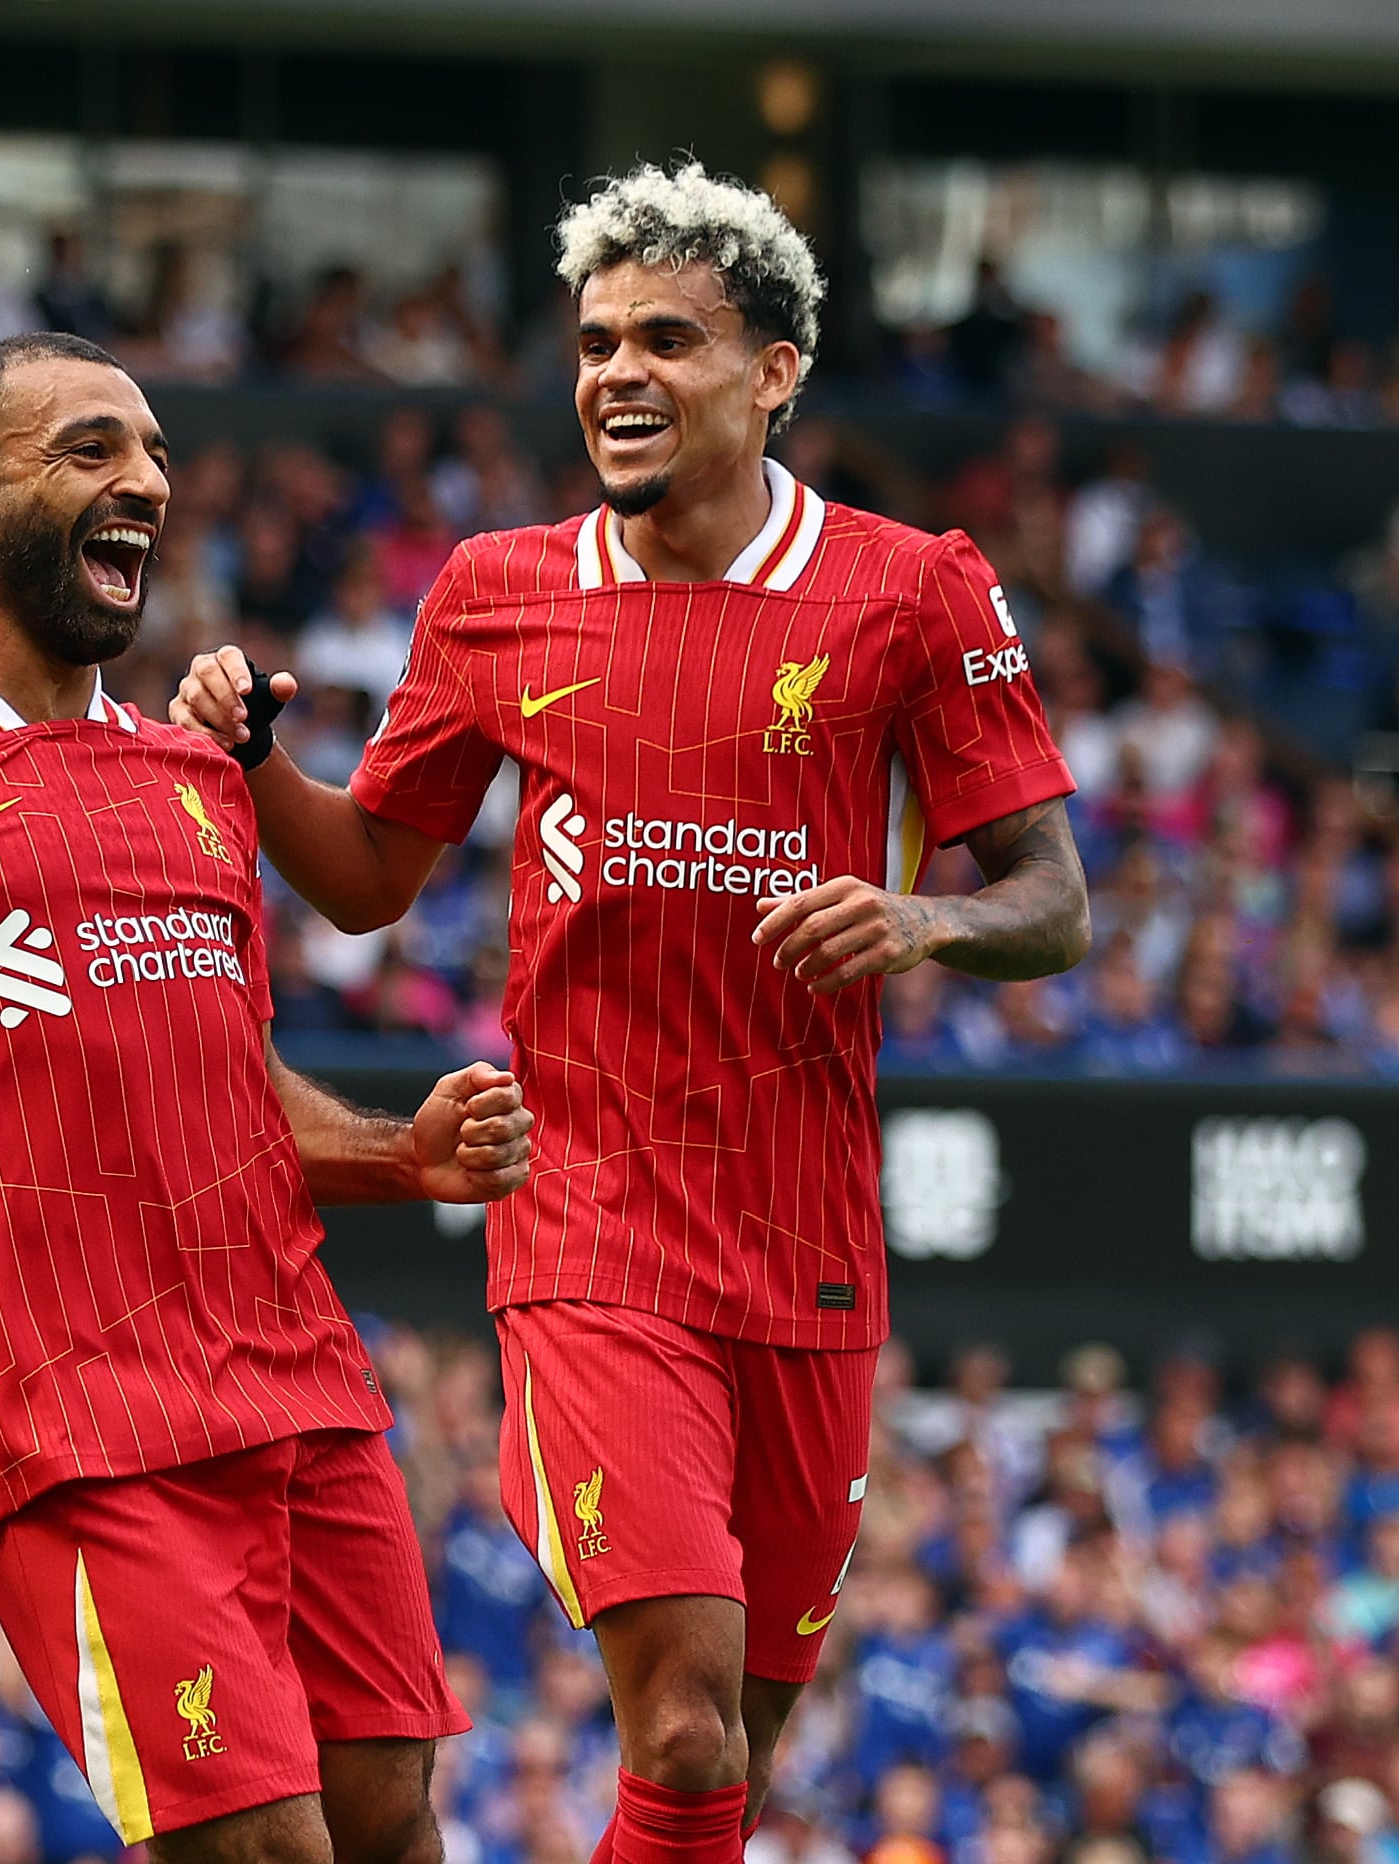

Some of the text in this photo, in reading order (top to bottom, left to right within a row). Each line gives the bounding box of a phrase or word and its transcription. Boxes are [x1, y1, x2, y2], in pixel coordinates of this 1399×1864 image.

[963, 643, 1029, 686] Expe
[763, 731, 814, 755] L.F.C.
[604, 811, 808, 861] standard
[602, 850, 818, 898] chartered
[76, 906, 234, 952] standard
[88, 942, 246, 988] chartered
[577, 1535, 612, 1560] L.F.C.
[182, 1735, 228, 1761] L.F.C.
